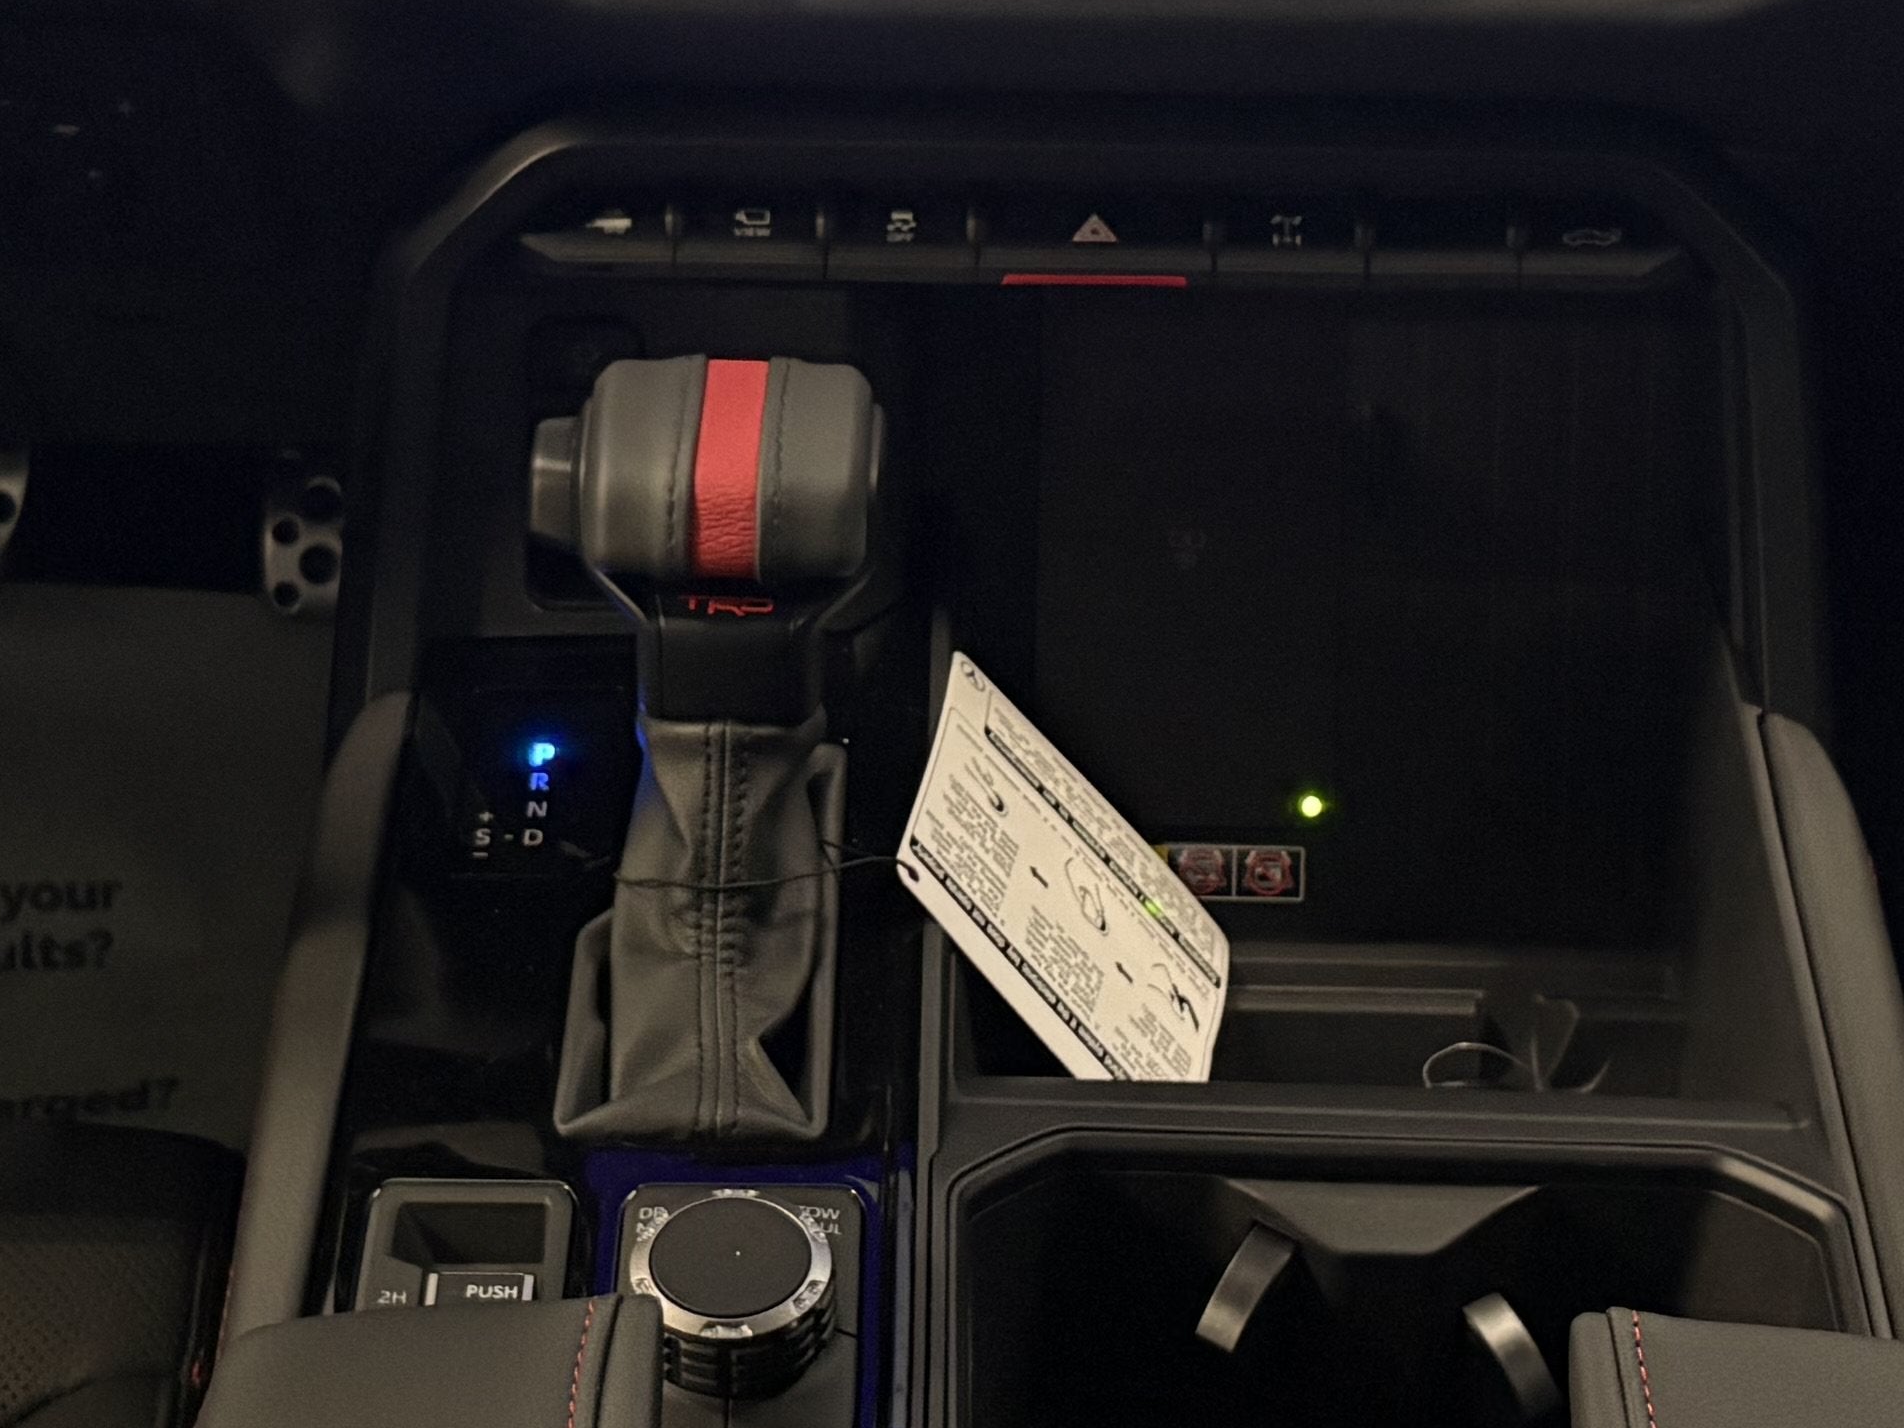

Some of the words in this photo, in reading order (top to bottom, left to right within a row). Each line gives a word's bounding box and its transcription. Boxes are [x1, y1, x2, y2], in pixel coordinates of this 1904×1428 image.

[528, 741, 557, 768] P
[528, 771, 551, 792] R
[526, 800, 549, 819] N
[475, 827, 493, 847] S
[522, 828, 545, 847] D
[377, 1289, 407, 1305] 2H
[465, 1284, 518, 1300] PUSH
